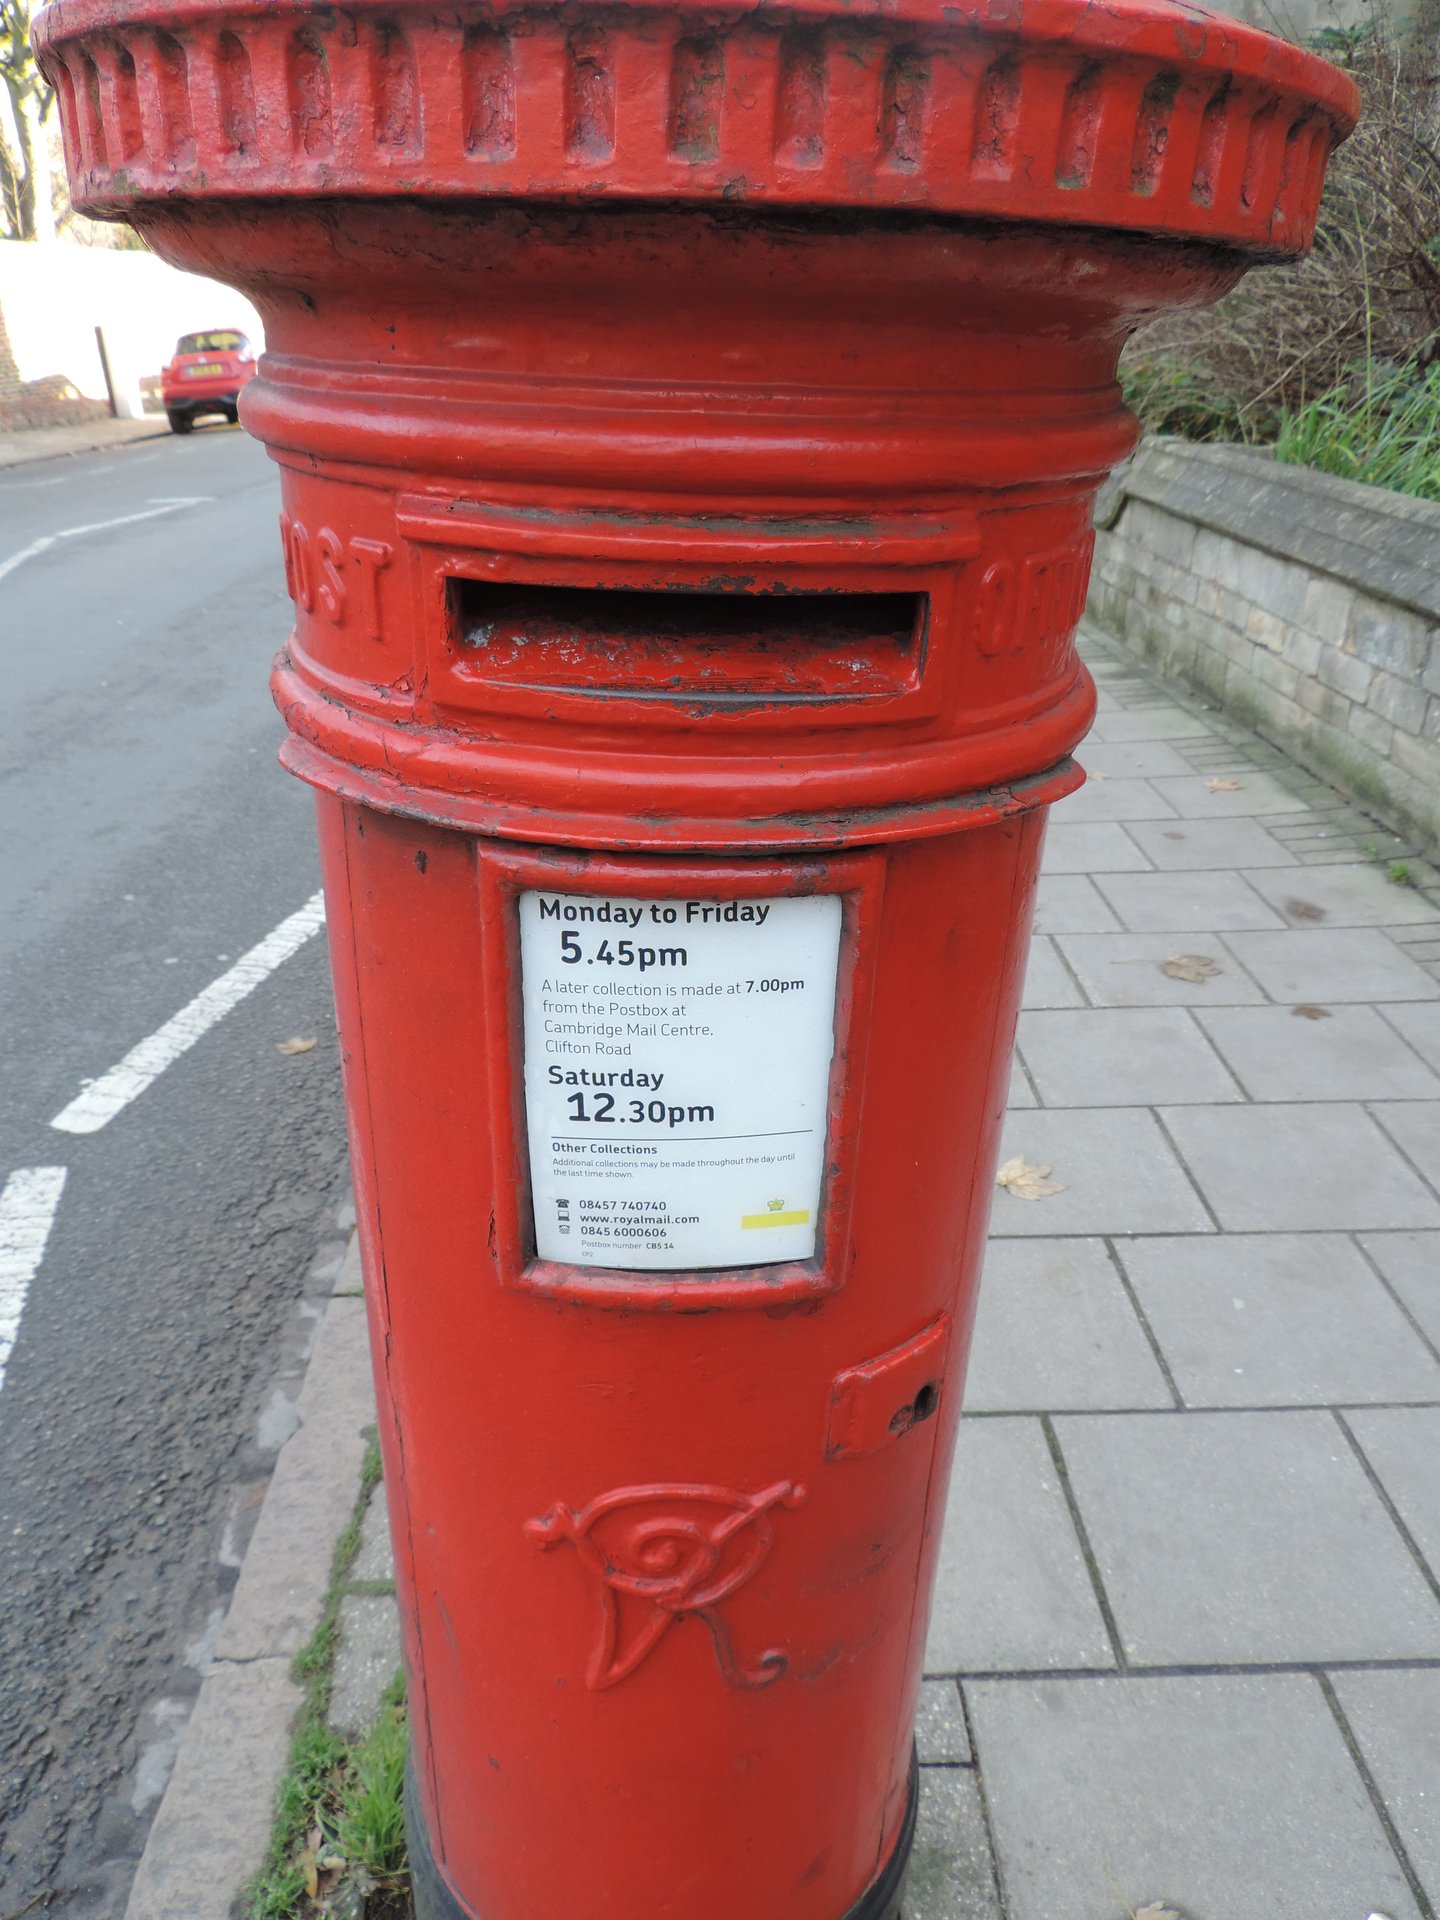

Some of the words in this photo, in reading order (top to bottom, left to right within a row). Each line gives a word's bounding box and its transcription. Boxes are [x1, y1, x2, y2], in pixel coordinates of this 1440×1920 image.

[539, 899, 643, 927] Monday
[650, 904, 677, 924] to
[686, 902, 770, 926] Friday
[560, 930, 688, 971] 5.45pm
[542, 981, 552, 992] A
[555, 980, 589, 995] later
[592, 982, 662, 996] collection
[666, 983, 677, 996] is
[681, 982, 723, 996] made
[726, 982, 741, 994] at
[745, 978, 805, 994] 7.00pm
[542, 1000, 578, 1014] from
[582, 1002, 605, 1015] the
[609, 1002, 668, 1016] Postbox
[672, 1005, 686, 1016] at
[544, 1020, 623, 1037] Cambridge
[627, 1023, 657, 1036] Mail
[545, 1040, 591, 1054] Clifton
[595, 1042, 632, 1056] Road
[548, 1065, 664, 1091] Saturday
[567, 1092, 715, 1128] 12.30pm
[552, 1142, 587, 1154] Other
[590, 1144, 657, 1155] Collections
[552, 1158, 594, 1167] Additional
[595, 1159, 638, 1168] collections
[640, 1161, 658, 1169] may
[660, 1160, 671, 1168] be
[672, 1159, 696, 1168] made
[697, 1156, 744, 1167] throughout
[745, 1155, 759, 1164] the
[760, 1154, 776, 1163] day
[777, 1153, 795, 1162] until
[553, 1168, 567, 1176] the
[568, 1169, 583, 1177] last
[584, 1169, 603, 1177] time
[579, 1200, 616, 1210] 08457
[621, 1201, 666, 1210] 740740
[580, 1215, 699, 1226] www.royalmail.com
[581, 1226, 610, 1235] 0845
[614, 1228, 666, 1237] 6000606
[582, 1240, 610, 1248] Postbox
